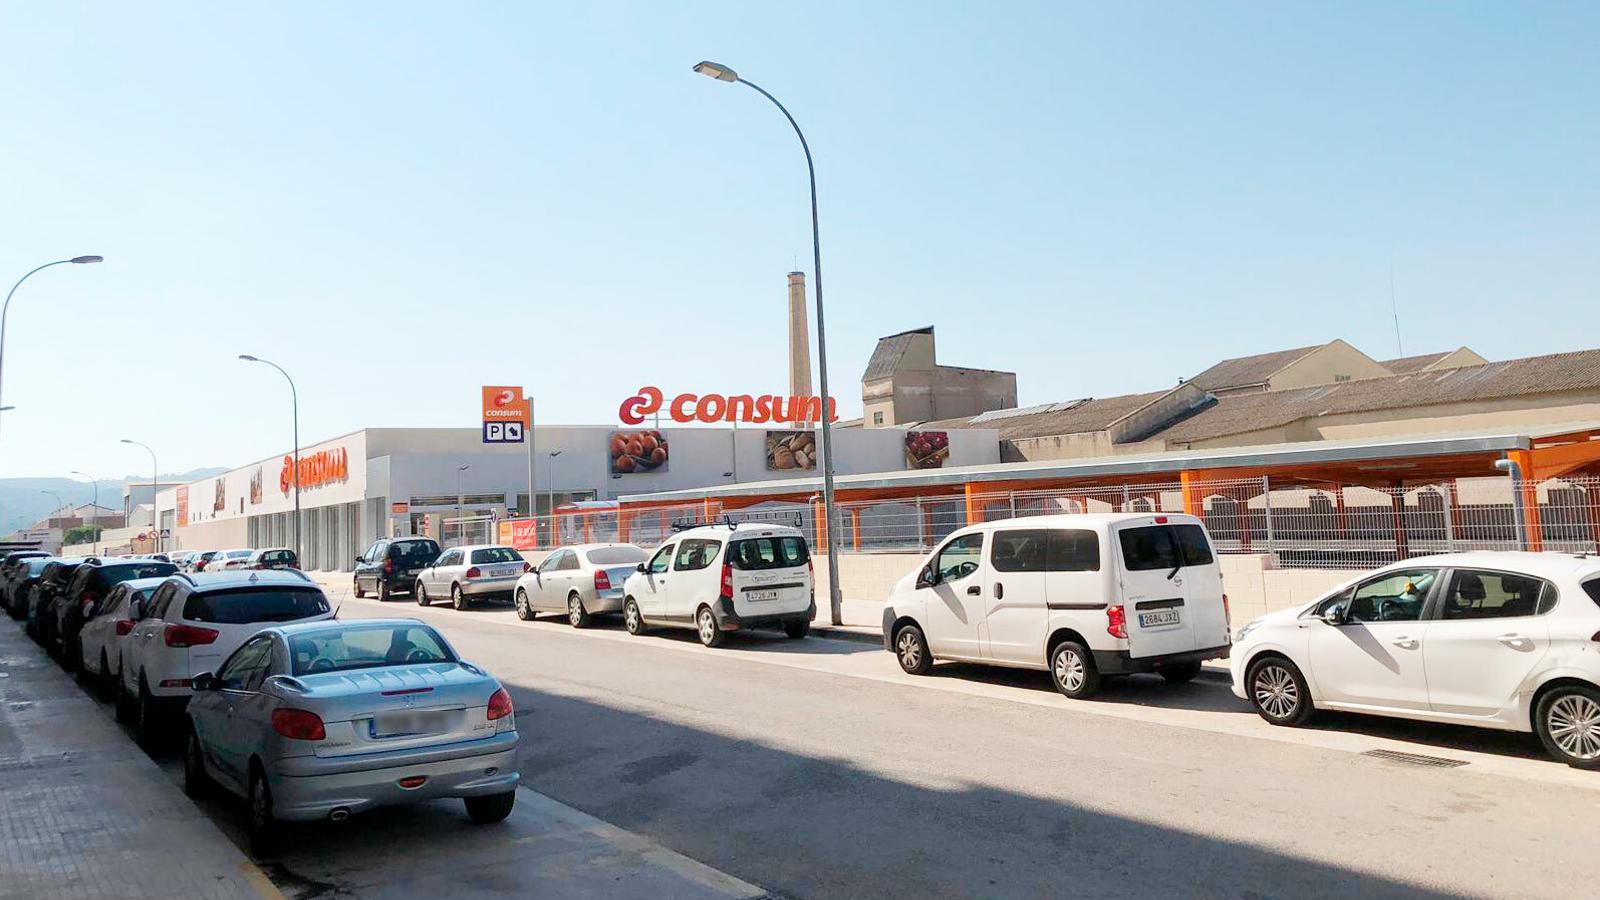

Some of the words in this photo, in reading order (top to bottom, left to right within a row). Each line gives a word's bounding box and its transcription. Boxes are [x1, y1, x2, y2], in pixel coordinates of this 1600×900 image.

[486, 409, 522, 417] consum
[670, 394, 838, 422] consum
[491, 425, 500, 439] P
[1144, 613, 1163, 624] 2684
